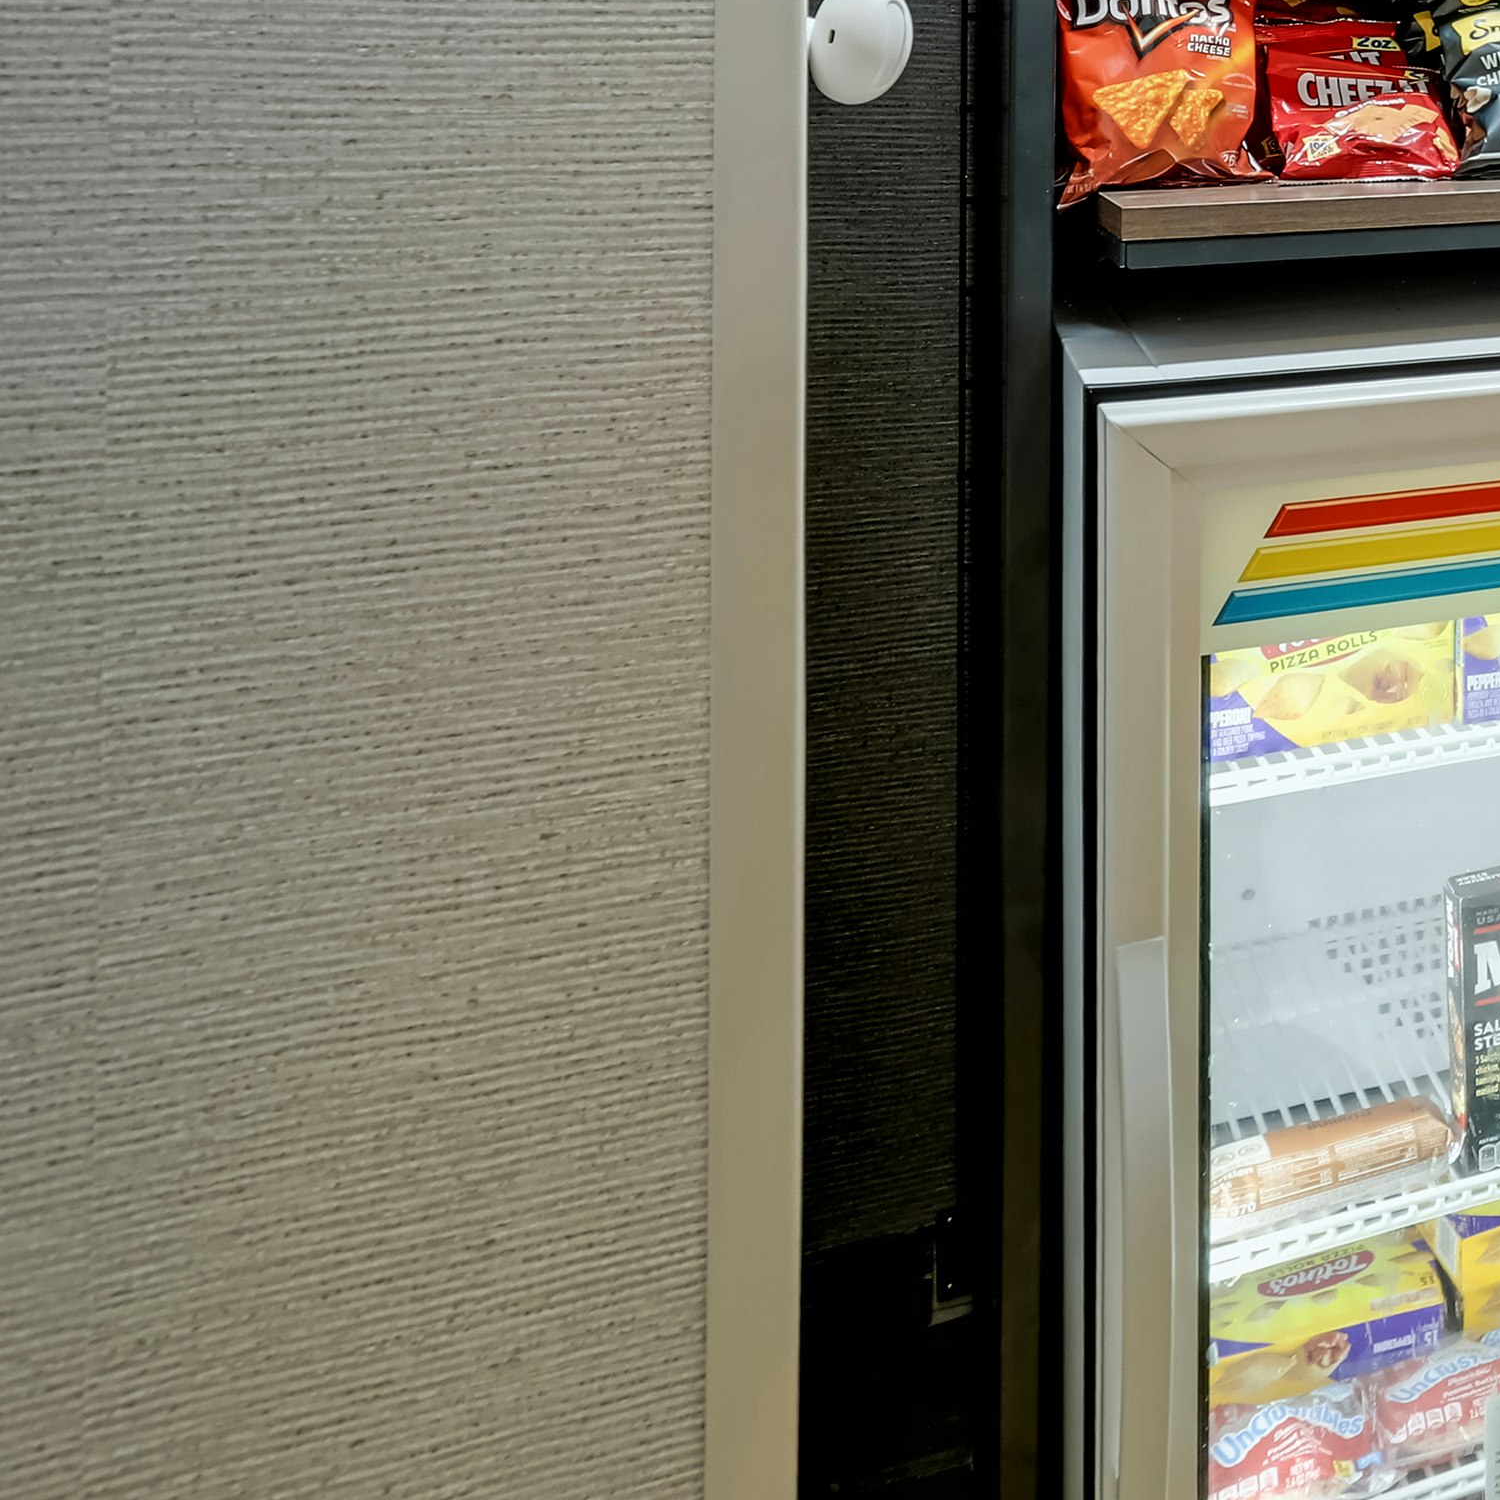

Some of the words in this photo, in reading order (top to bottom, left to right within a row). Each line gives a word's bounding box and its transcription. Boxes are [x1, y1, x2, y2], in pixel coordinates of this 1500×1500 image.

[1189, 33, 1231, 46] NACHO
[1356, 36, 1370, 48] 2
[1186, 41, 1232, 57] CHEESE
[1269, 649, 1319, 674] PIZZA
[1326, 630, 1378, 656] ROLLS
[1269, 1255, 1368, 1294] Totino's
[1420, 1275, 1435, 1286] 15
